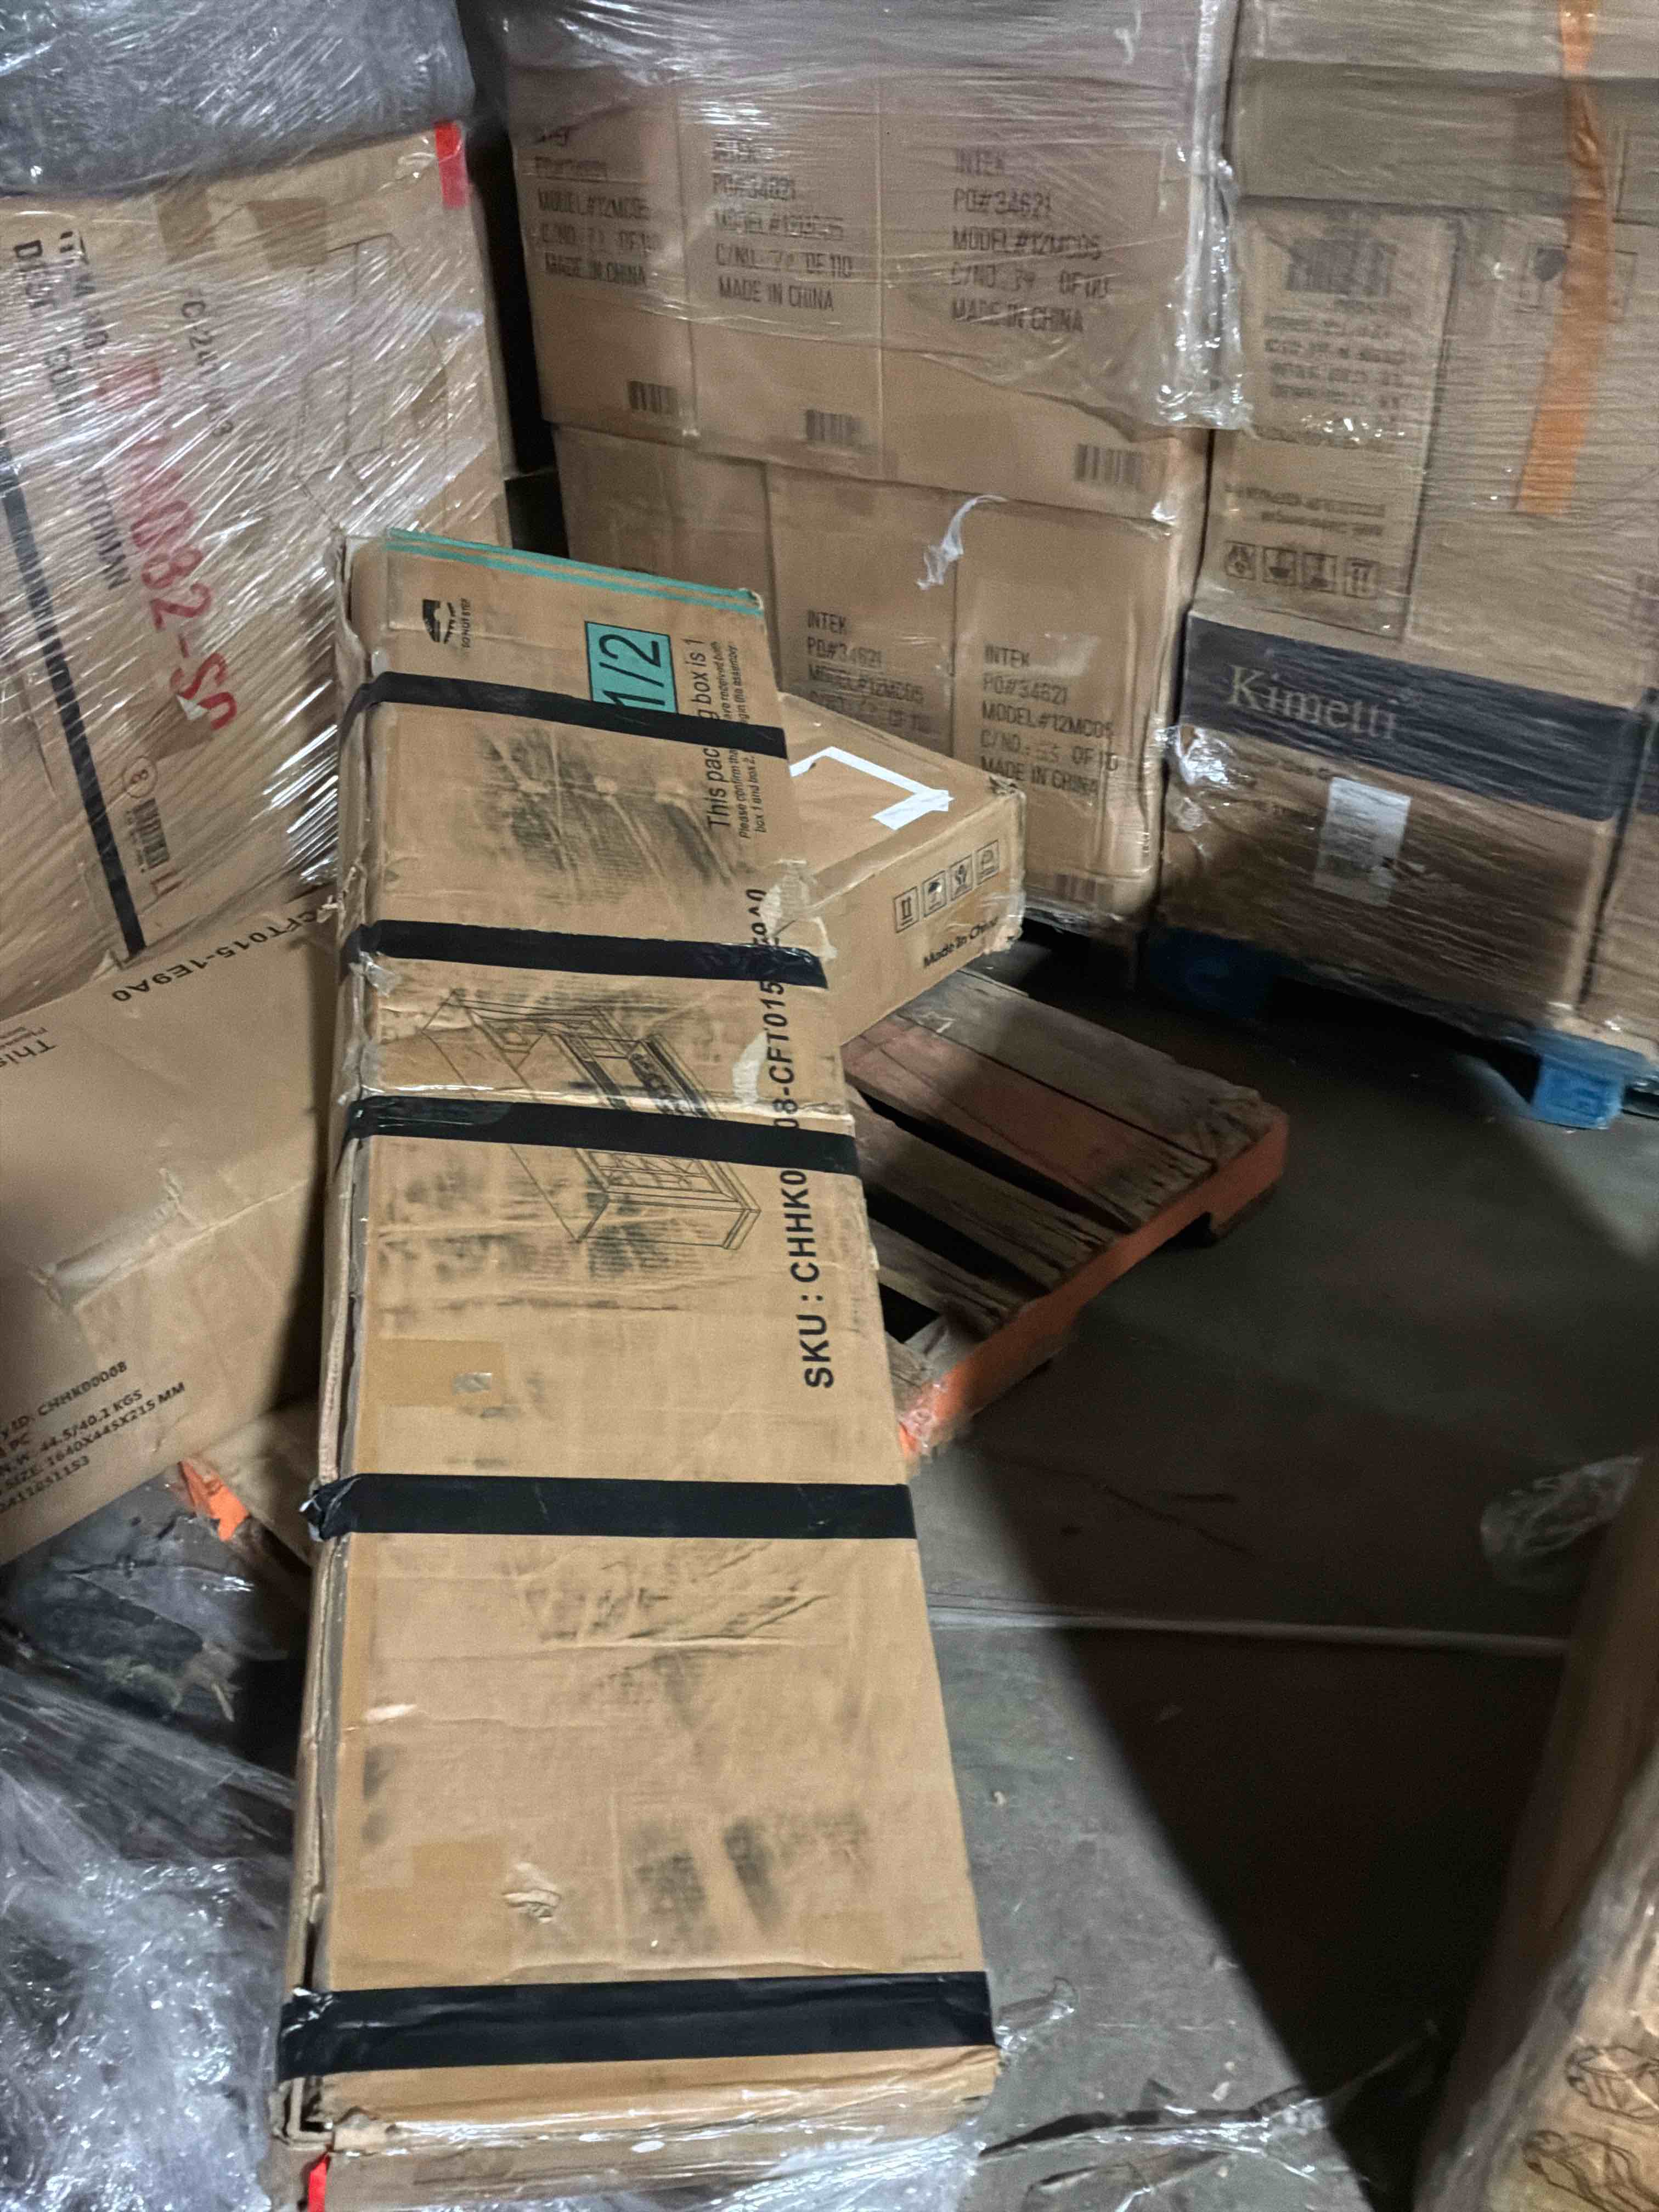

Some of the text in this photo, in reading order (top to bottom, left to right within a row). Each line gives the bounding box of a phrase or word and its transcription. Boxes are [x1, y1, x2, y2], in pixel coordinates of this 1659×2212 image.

[684, 652, 707, 668] is
[690, 670, 712, 704] box
[697, 709, 729, 783] pacg
[705, 785, 731, 831] This
[804, 1313, 834, 1390] SKU
[113, 1389, 143, 1412] KGS
